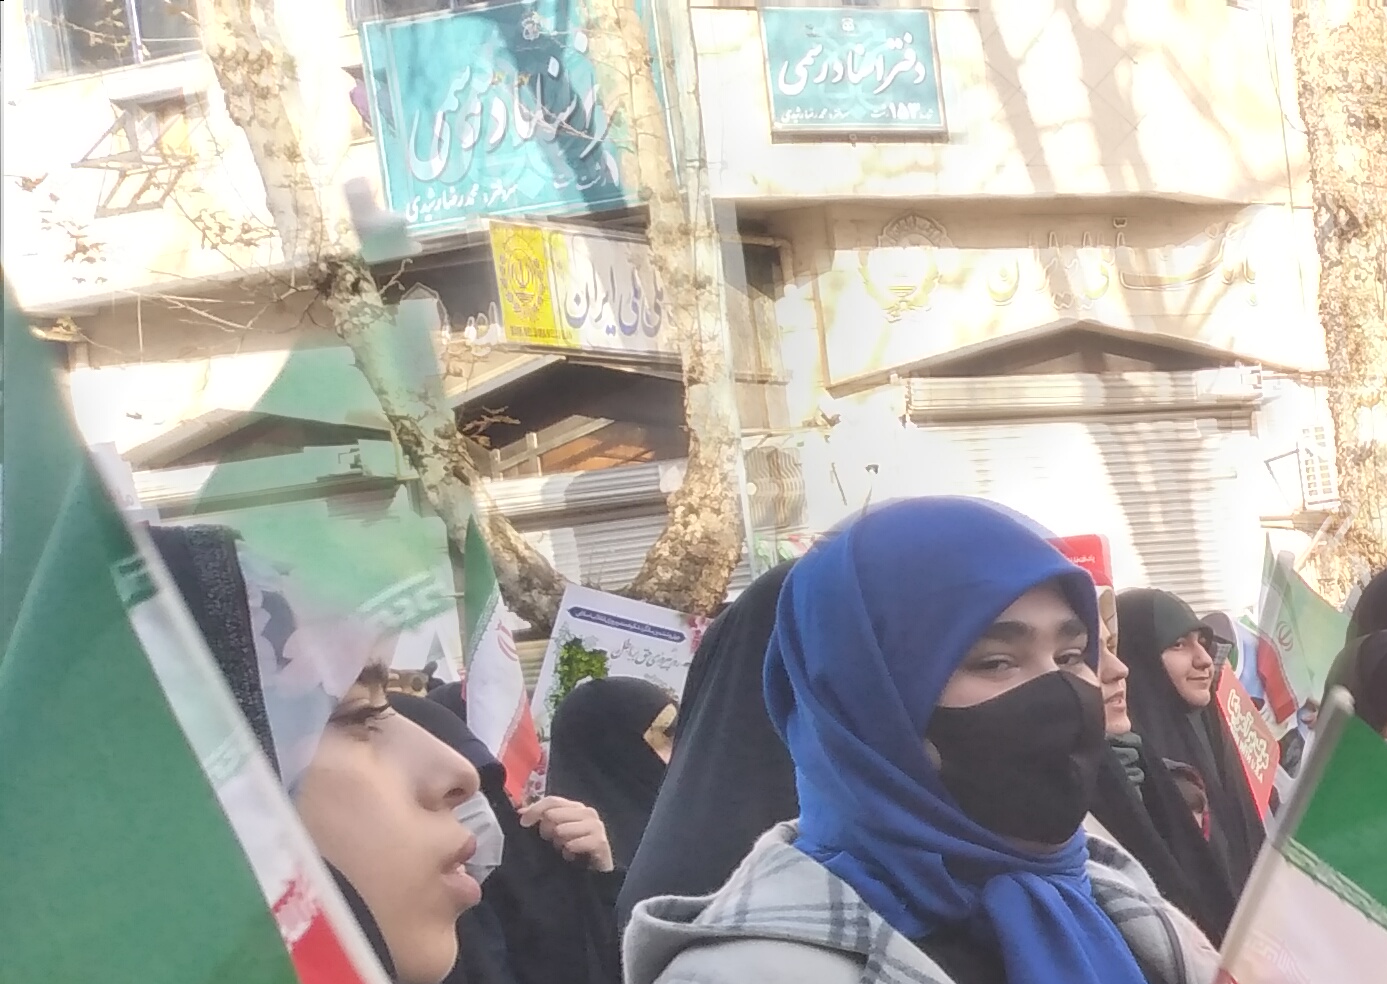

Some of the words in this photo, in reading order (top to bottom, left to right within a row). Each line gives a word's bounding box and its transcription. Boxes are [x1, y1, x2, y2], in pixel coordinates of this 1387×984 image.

[778, 44, 829, 96] رسمی
[831, 43, 884, 84] اسناد
[873, 32, 925, 94] دفتر
